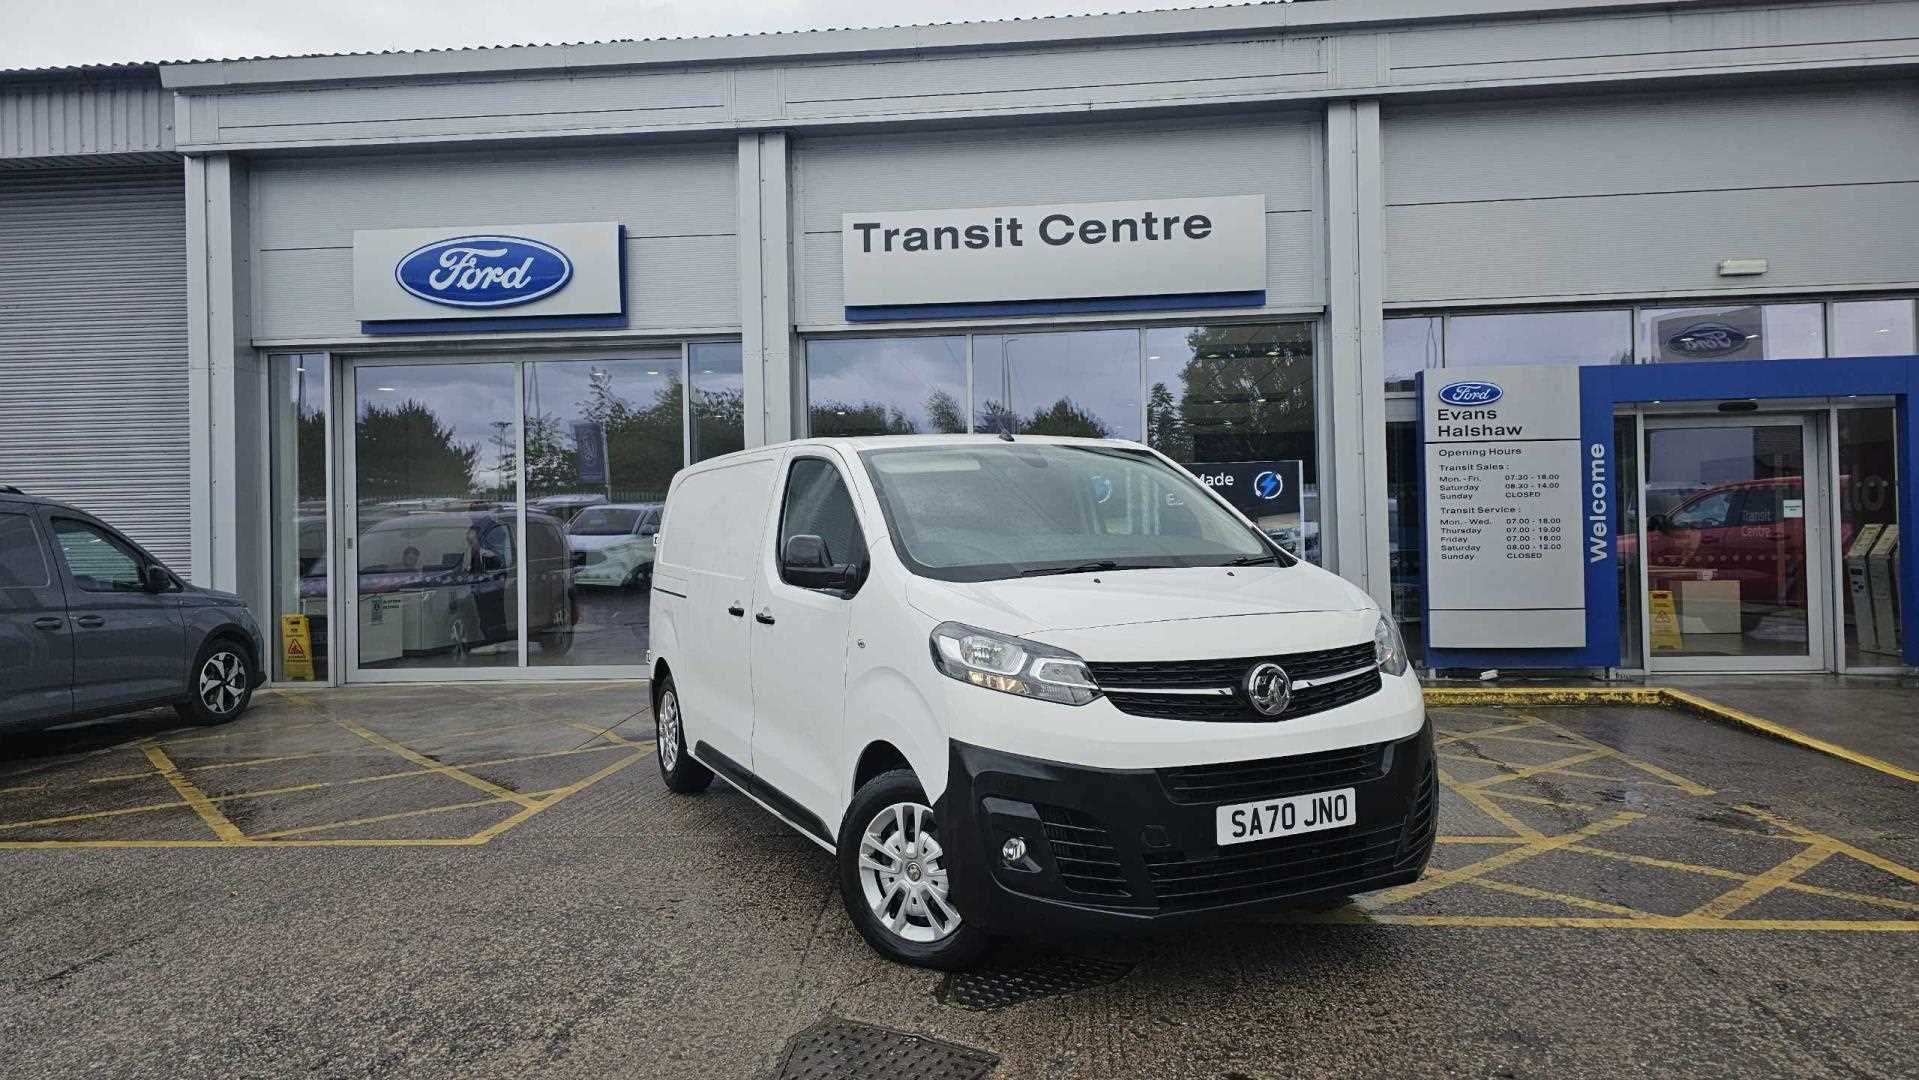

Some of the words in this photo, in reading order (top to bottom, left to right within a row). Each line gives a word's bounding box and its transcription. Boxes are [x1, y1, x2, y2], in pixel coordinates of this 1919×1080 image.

[853, 217, 1023, 253] Transit
[1039, 211, 1212, 247] Centre
[429, 247, 536, 291] Ford
[1452, 385, 1491, 401] Ford
[1437, 408, 1497, 421] Evans
[1438, 424, 1523, 437] Halshaw
[1438, 449, 1486, 458] Opening
[1440, 463, 1474, 472] Transit
[1476, 463, 1504, 471] Sales
[1439, 484, 1480, 492] Saturday
[1440, 493, 1473, 501] Sunday
[1589, 443, 1608, 564] Welcome
[1477, 506, 1516, 514] Service
[1441, 527, 1482, 535] Thursday
[1441, 544, 1481, 552] Saturday
[1441, 553, 1475, 561] Sunday
[1231, 802, 1296, 838] SA70
[1303, 794, 1348, 827] JNO
